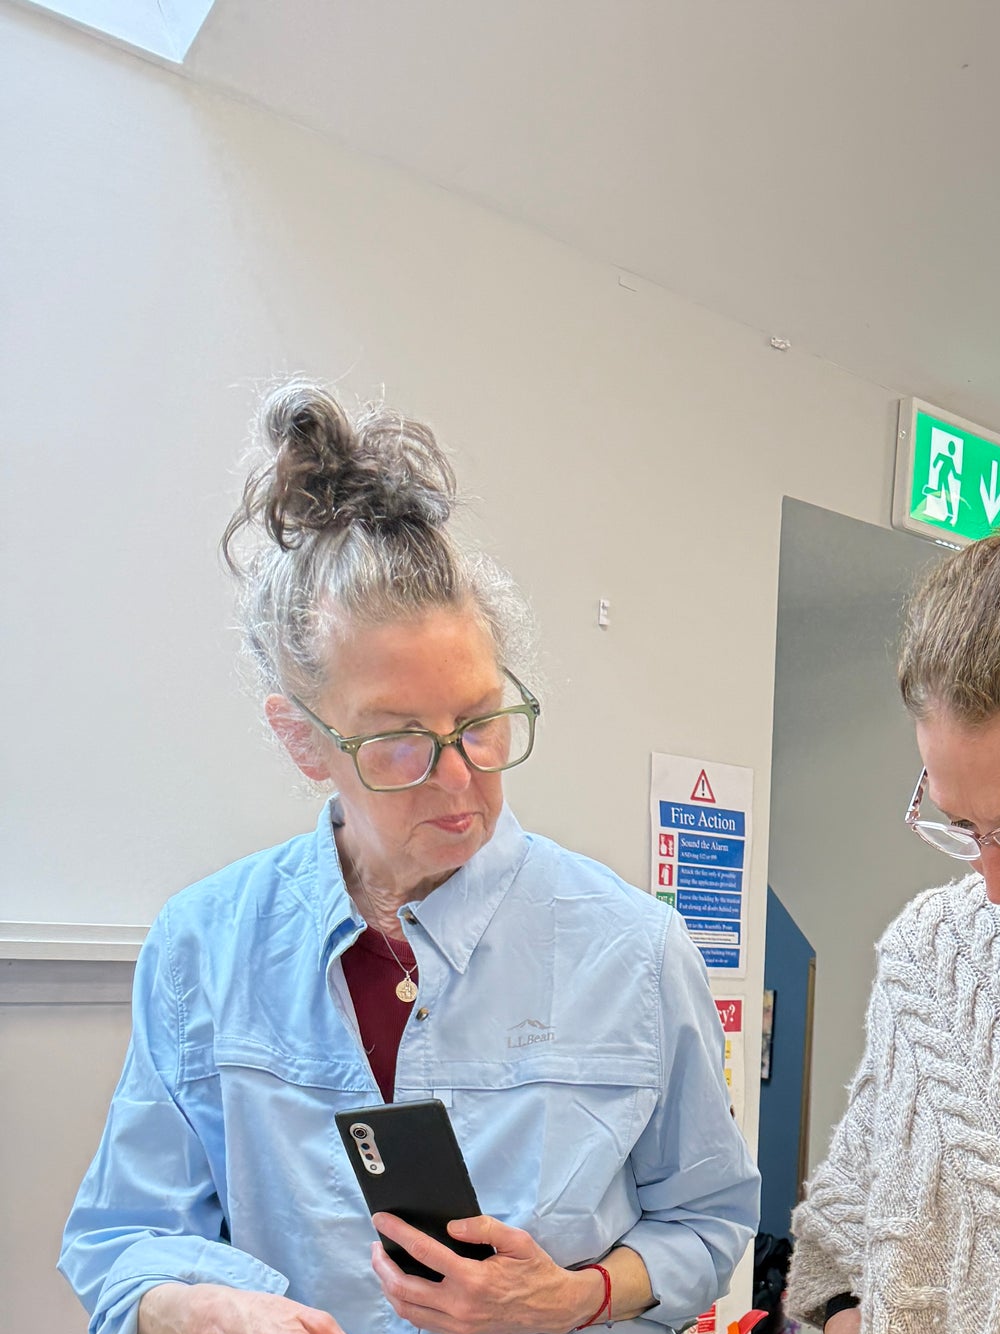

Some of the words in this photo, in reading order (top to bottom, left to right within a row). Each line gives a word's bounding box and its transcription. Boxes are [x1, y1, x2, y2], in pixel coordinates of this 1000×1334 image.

[671, 807, 695, 826] Fire
[698, 810, 736, 831] Action
[680, 838, 700, 849] Sound
[700, 840, 710, 850] the
[710, 840, 729, 852] Alarm
